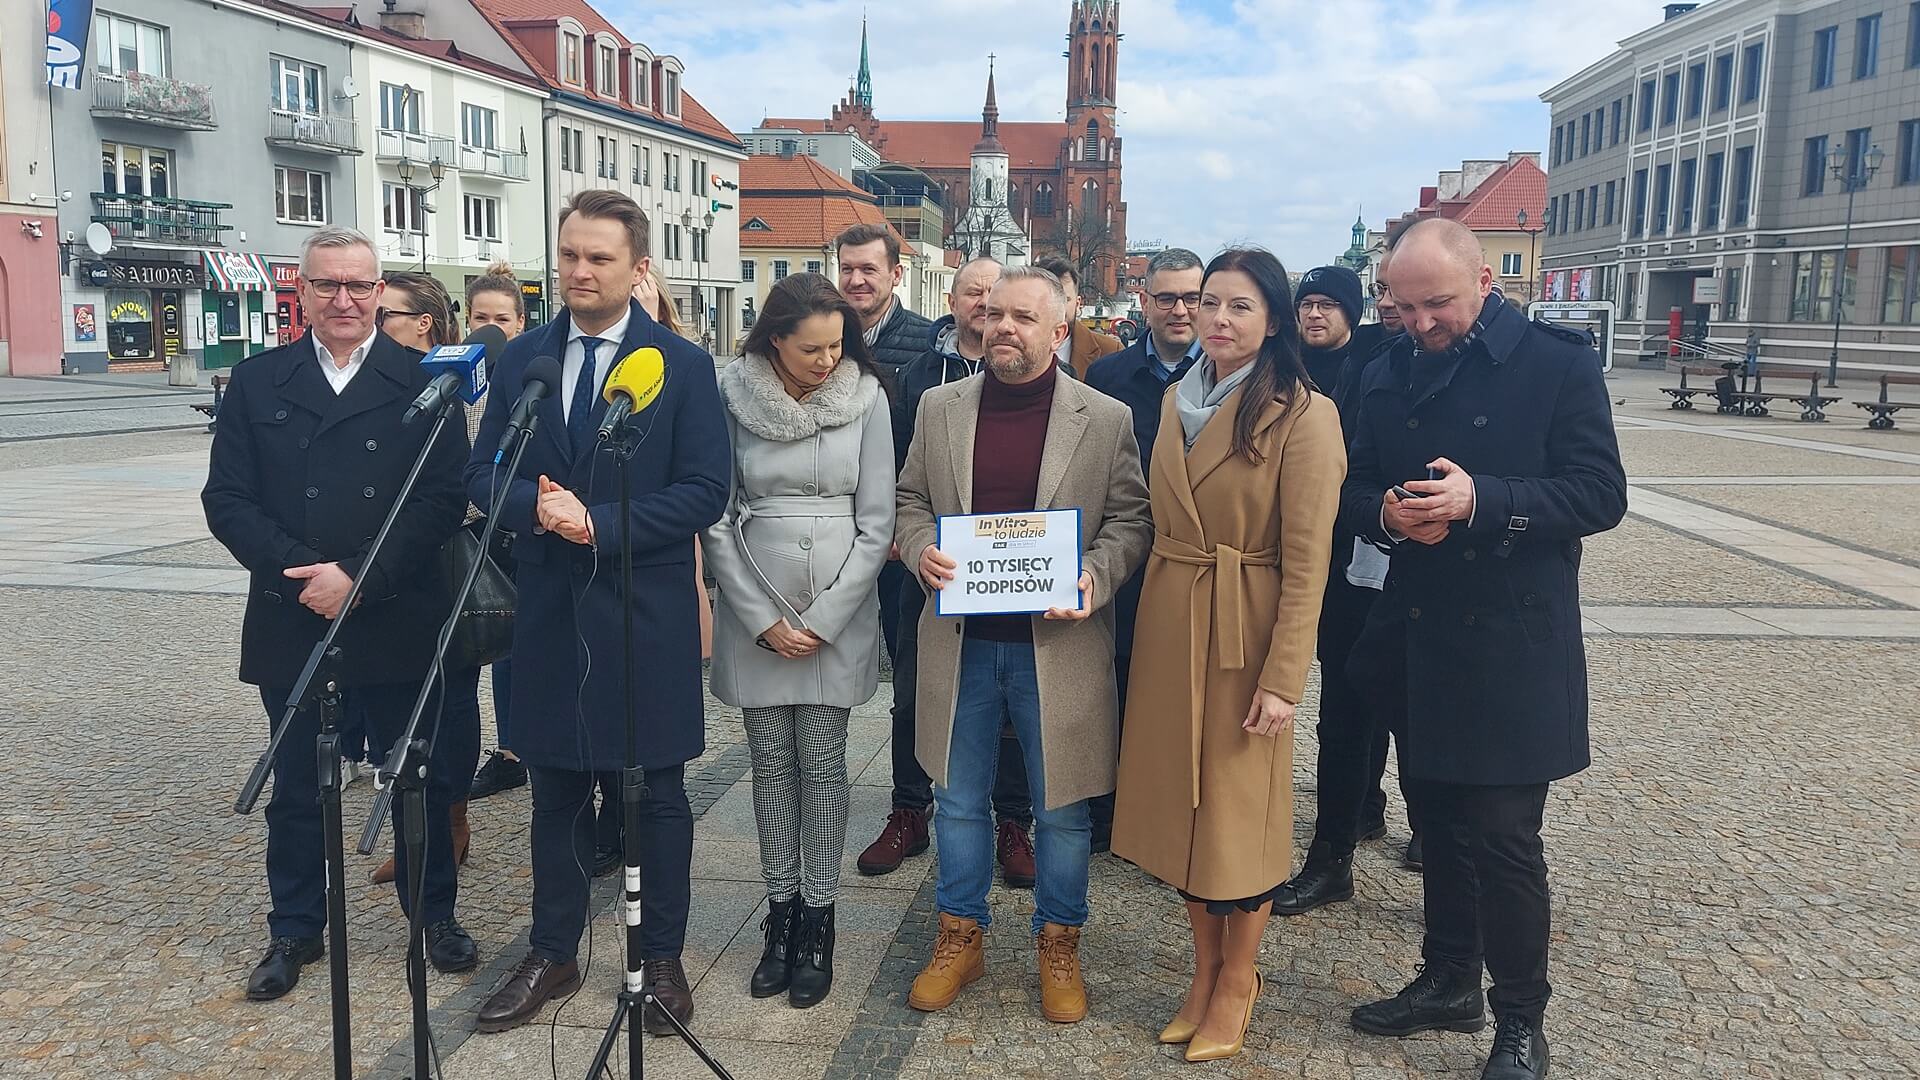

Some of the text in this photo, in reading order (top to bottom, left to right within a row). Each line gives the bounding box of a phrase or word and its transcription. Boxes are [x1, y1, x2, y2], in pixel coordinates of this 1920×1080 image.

[111, 301, 147, 320] SAVONA
[979, 517, 1028, 530] In Vitro
[994, 526, 1046, 540] to ludzie
[967, 557, 1053, 576] 10 TYSIĘCY
[966, 574, 1054, 595] PODPISÓW
